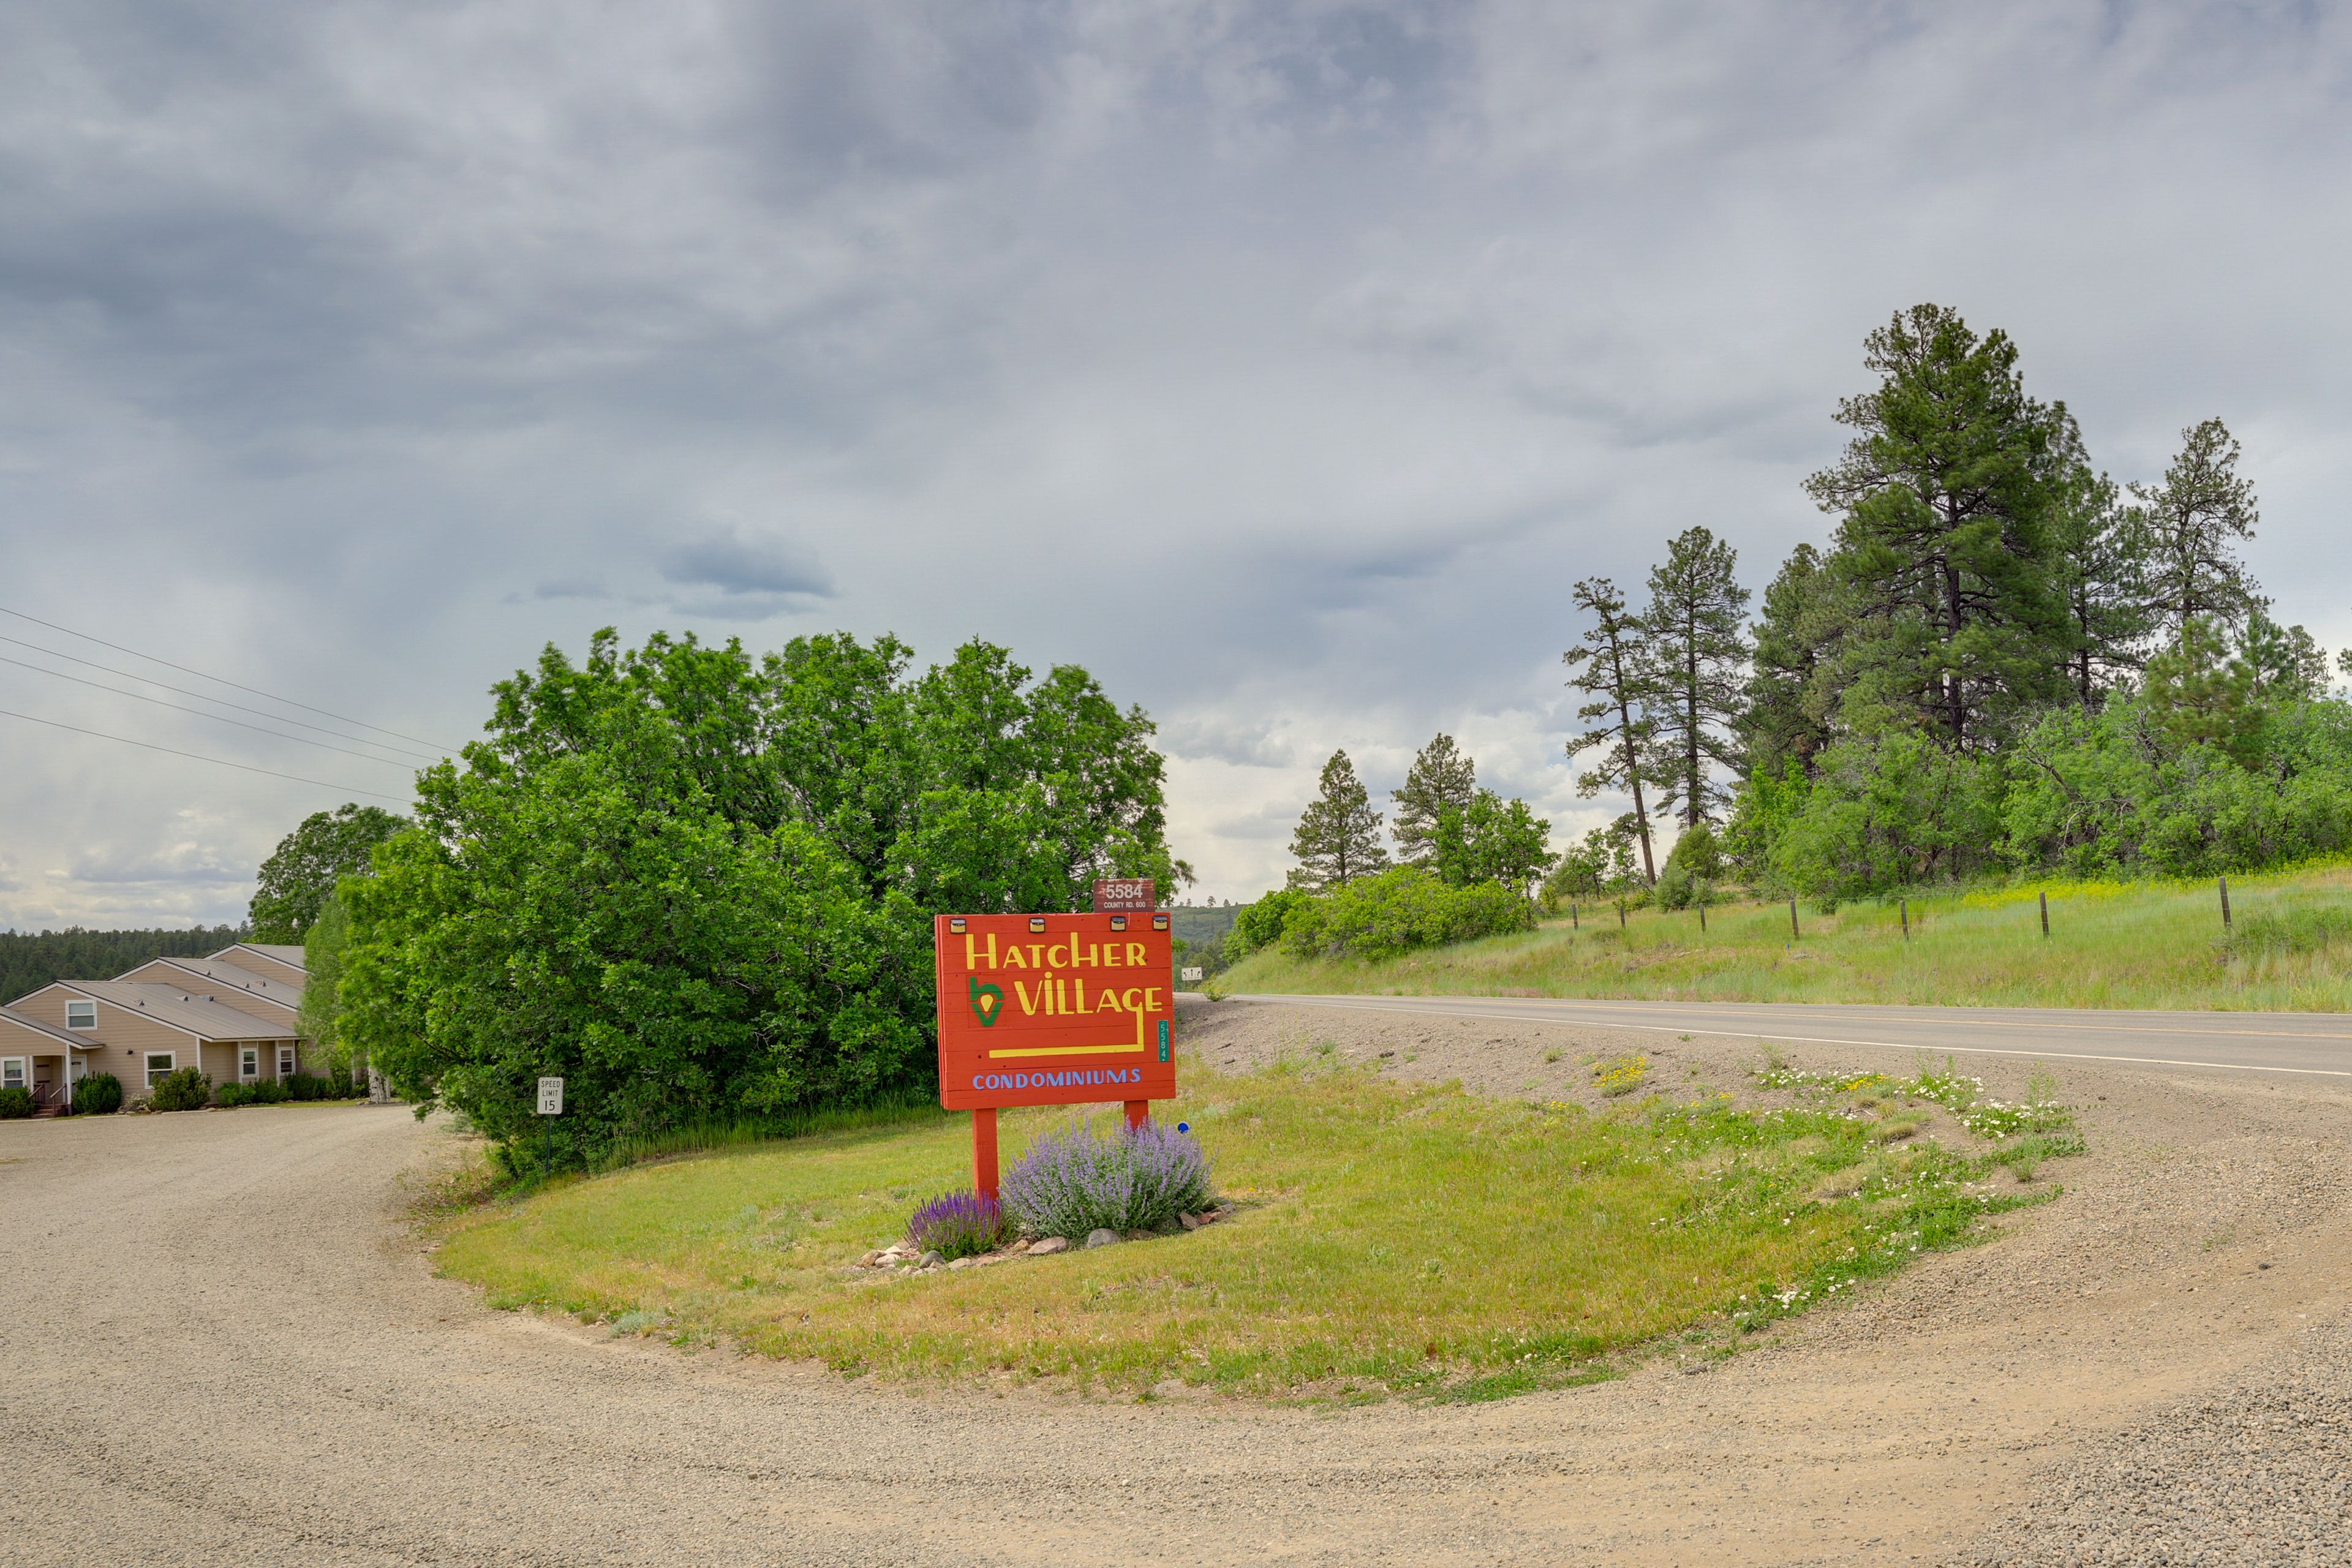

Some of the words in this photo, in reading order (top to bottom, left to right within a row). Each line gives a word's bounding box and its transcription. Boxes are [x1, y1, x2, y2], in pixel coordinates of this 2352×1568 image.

[1106, 883, 1143, 899] 5584
[972, 1068, 1141, 1090] CONDOMINIUMS
[545, 1100, 555, 1111] 15
